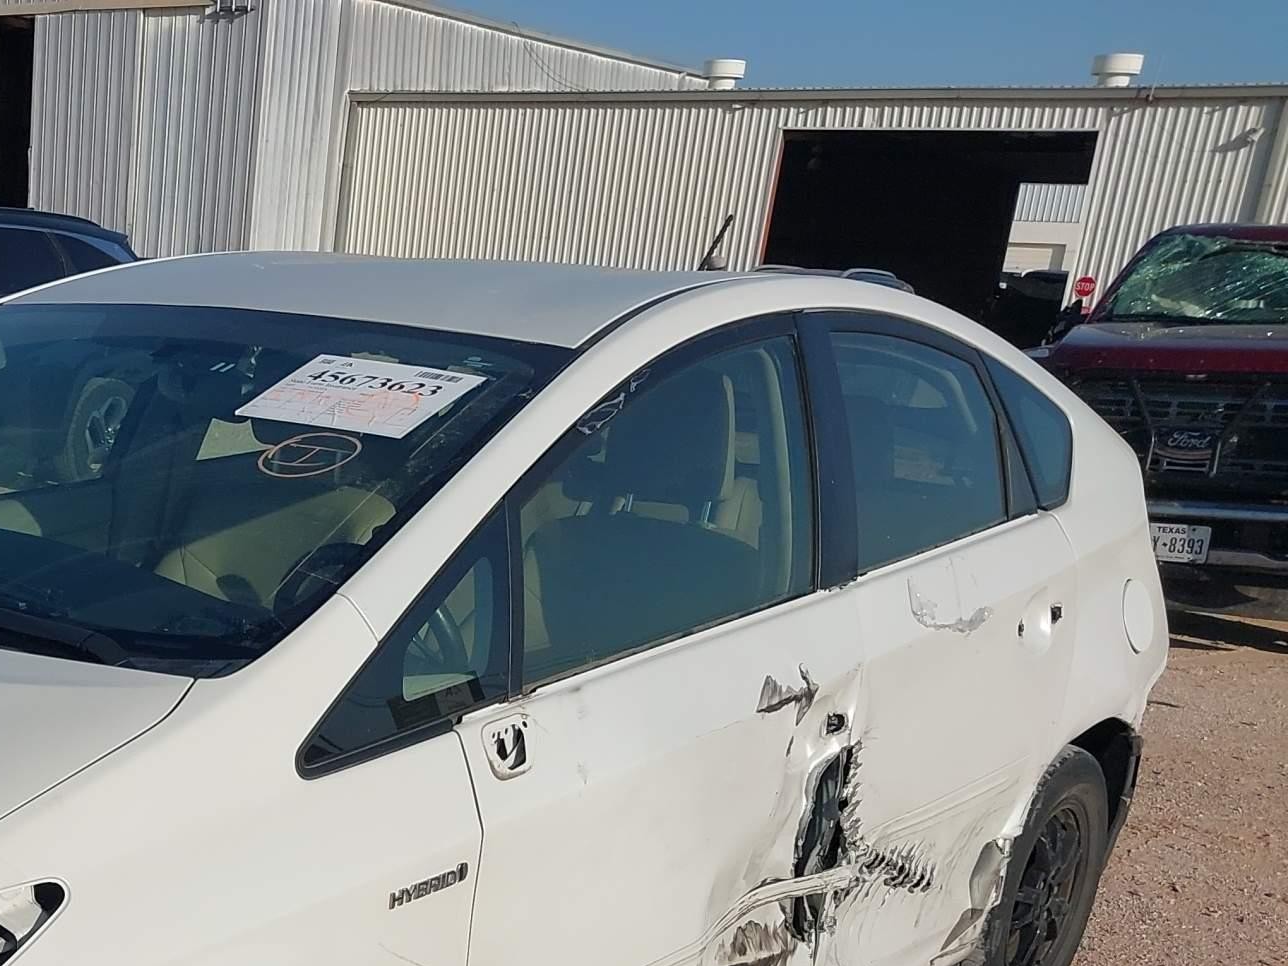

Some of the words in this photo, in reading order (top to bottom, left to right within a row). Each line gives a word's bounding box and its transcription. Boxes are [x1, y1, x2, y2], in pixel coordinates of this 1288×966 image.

[1076, 281, 1096, 291] STOP
[307, 370, 443, 397] 45673623
[1168, 431, 1211, 448] Ford
[1157, 526, 1187, 535] TEXAS
[388, 869, 458, 910] HYBRID
